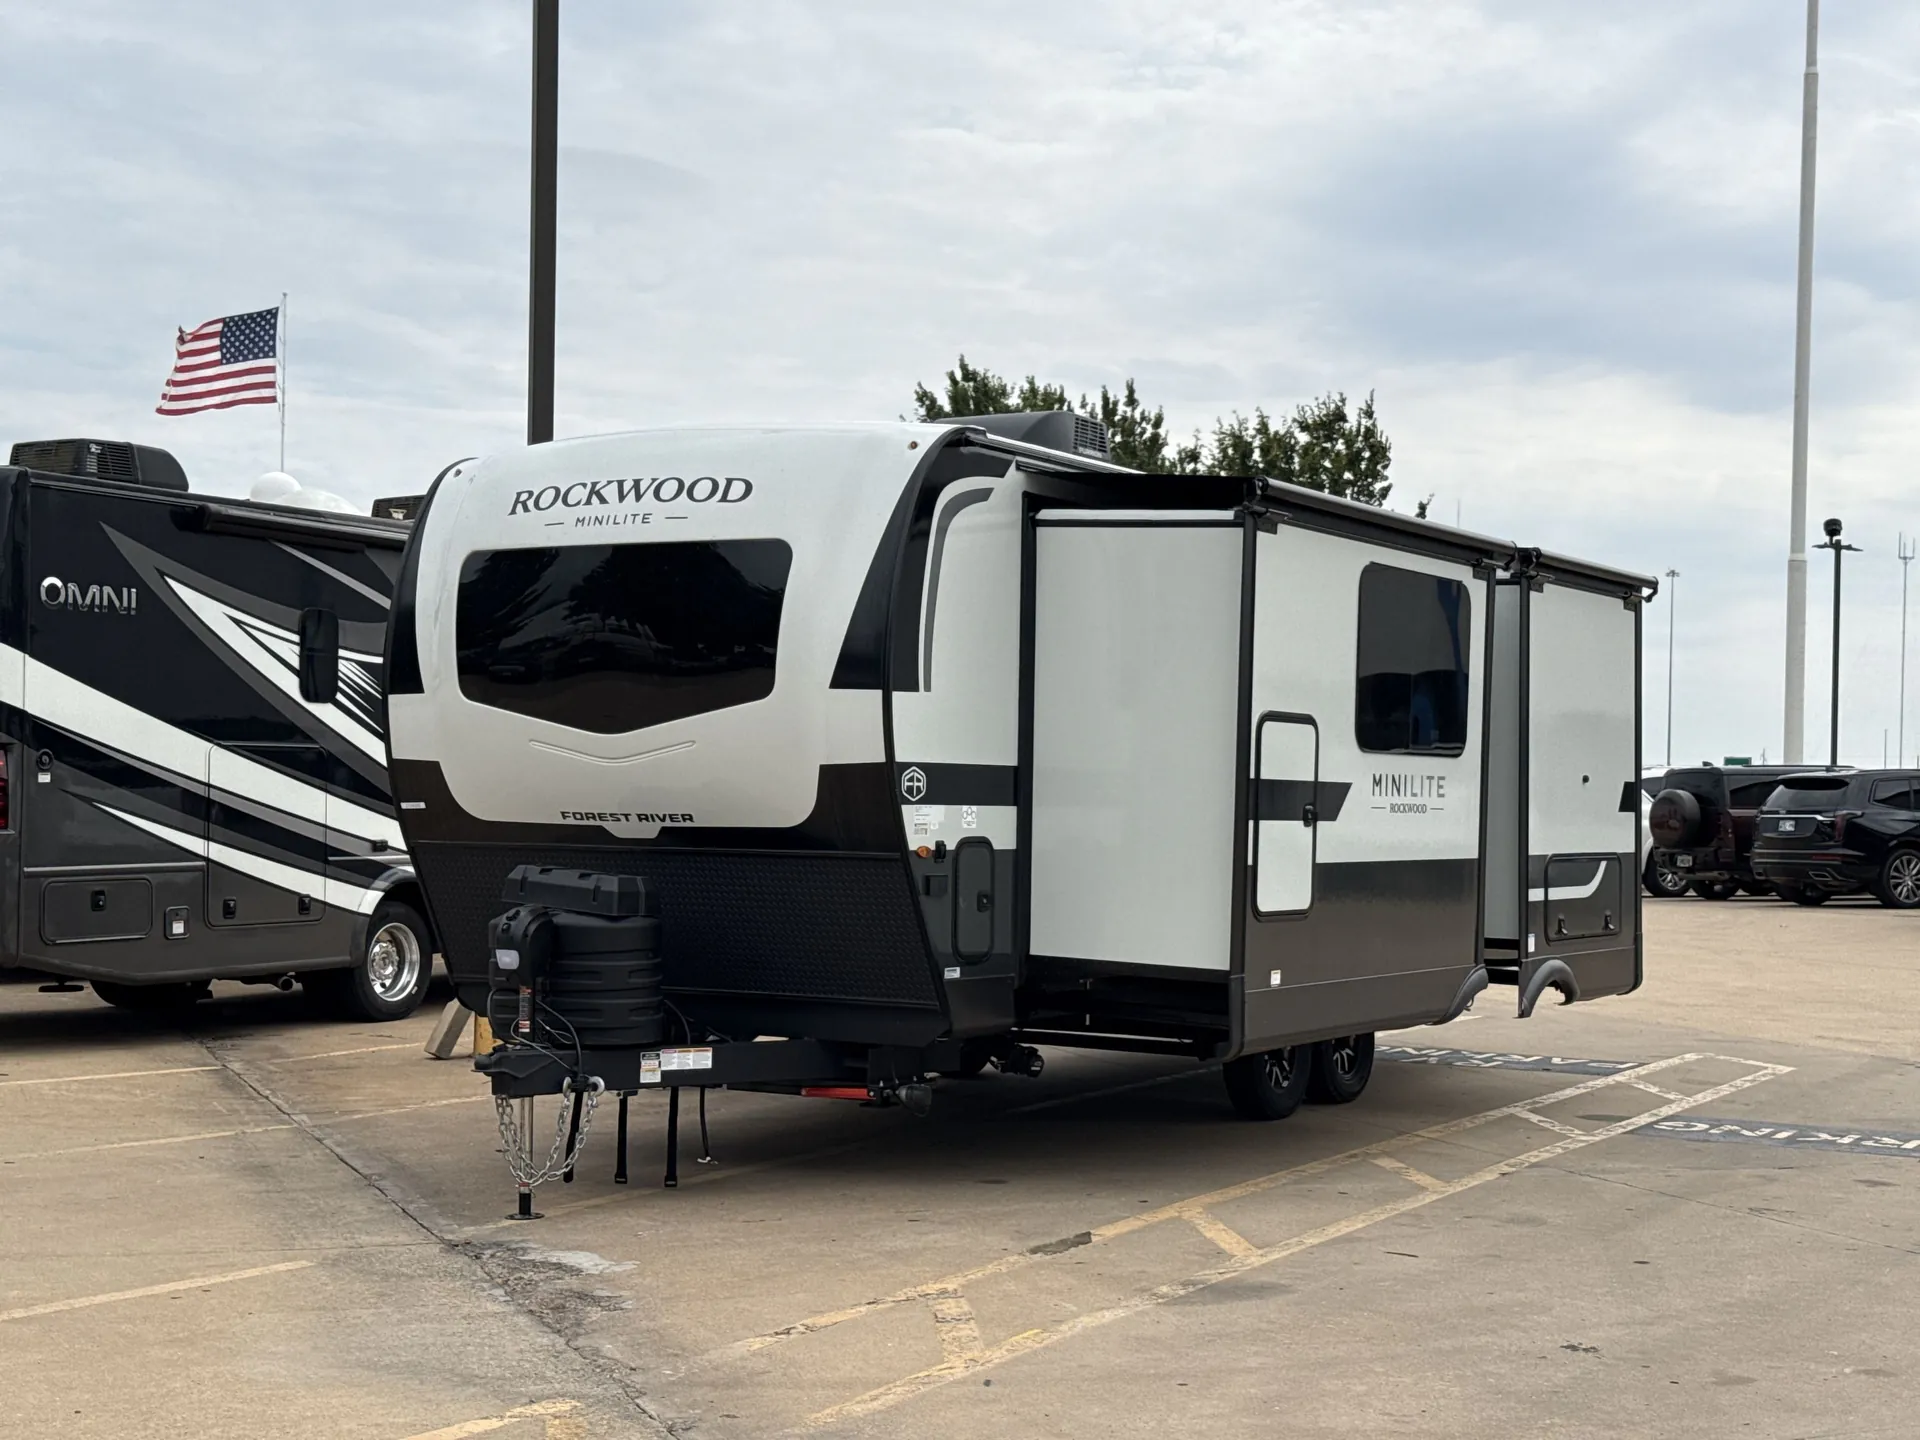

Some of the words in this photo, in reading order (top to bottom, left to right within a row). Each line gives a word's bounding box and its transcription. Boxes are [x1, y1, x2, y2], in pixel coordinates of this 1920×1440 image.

[507, 476, 753, 516] ROCKWOOD
[575, 512, 653, 528] MINILITE
[40, 576, 137, 615] OMNI
[1372, 773, 1446, 798] MINILITE
[560, 810, 632, 822] FOREST
[635, 812, 695, 823] RIVER
[1389, 803, 1428, 814] ROCKWOOD
